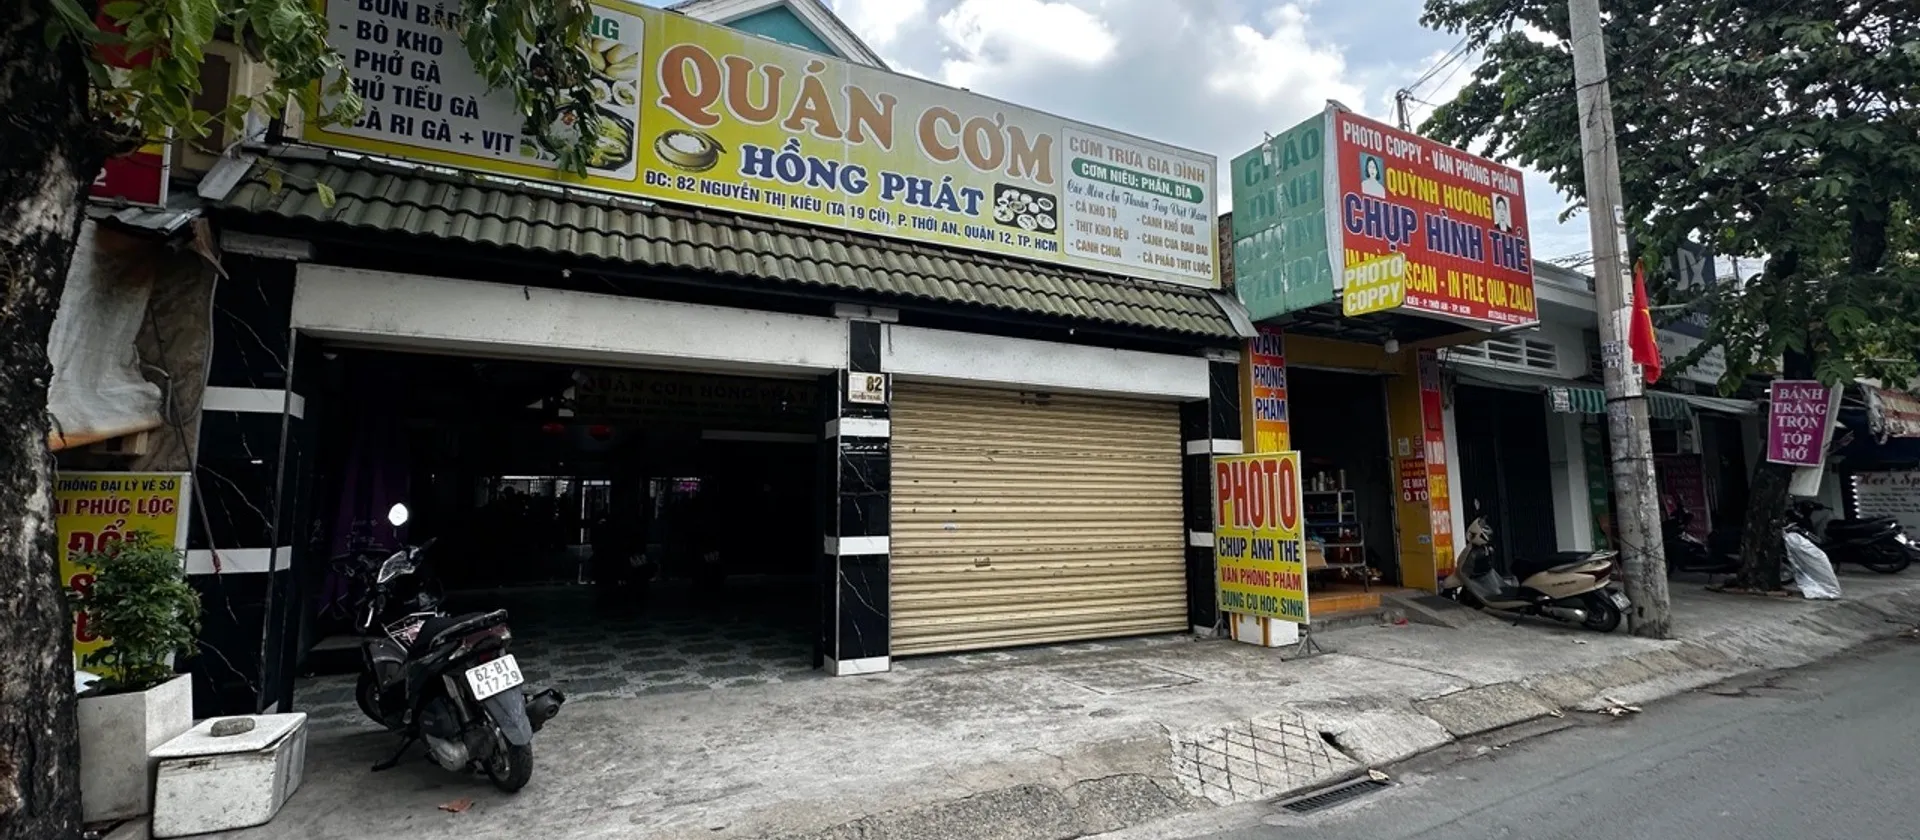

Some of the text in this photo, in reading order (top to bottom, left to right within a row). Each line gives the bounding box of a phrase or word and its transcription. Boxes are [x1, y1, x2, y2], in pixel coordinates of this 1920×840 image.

[356, 19, 443, 55] BÒ KHO
[354, 48, 441, 84] PHỞ GÀ
[392, 85, 443, 112] TIẾU
[450, 95, 479, 120] GÀ
[660, 44, 1054, 185] QUÁN CƠM
[390, 113, 414, 136] RI
[421, 119, 452, 143] GÀ
[482, 130, 514, 156] VỊT
[1343, 120, 1383, 152] PHOTO
[1386, 135, 1422, 165] COPPY
[740, 137, 984, 216] HỒNG PHÁT
[1069, 136, 1205, 183] CƠM TRƯA GIA ĐÌNH
[1081, 163, 1107, 180] CƠM
[1386, 167, 1492, 220] QUỲNH HƯƠNG
[677, 176, 695, 191] 82
[764, 190, 786, 210] THỊ
[850, 205, 865, 219] 19
[964, 225, 995, 243] QUẬN
[1017, 234, 1032, 249] TP.
[1034, 238, 1057, 253] HCM
[1344, 192, 1418, 251] CHỤP
[1424, 208, 1484, 263] HÌNH
[1488, 225, 1528, 274] THẺ
[1344, 256, 1400, 289] PHOTO
[1405, 261, 1437, 295] SCAN
[1447, 270, 1460, 298] IN
[1462, 272, 1484, 302] FILE
[1487, 277, 1508, 309] QUA
[1510, 281, 1533, 313] ZALO
[1348, 281, 1400, 313] COPPY
[867, 375, 882, 391] 82
[1779, 385, 1823, 400] BÁNH
[1773, 400, 1827, 415] TRÁNG
[1776, 415, 1820, 431] TRỘN
[100, 480, 121, 493] ĐẠI
[1216, 458, 1297, 530] PHOTO
[75, 495, 131, 515] PHÚC
[136, 495, 175, 517] LỘC
[1219, 530, 1300, 563] CHỤP ẢNH THẺ
[1281, 597, 1304, 618] SINH
[474, 659, 510, 682] 62-B1
